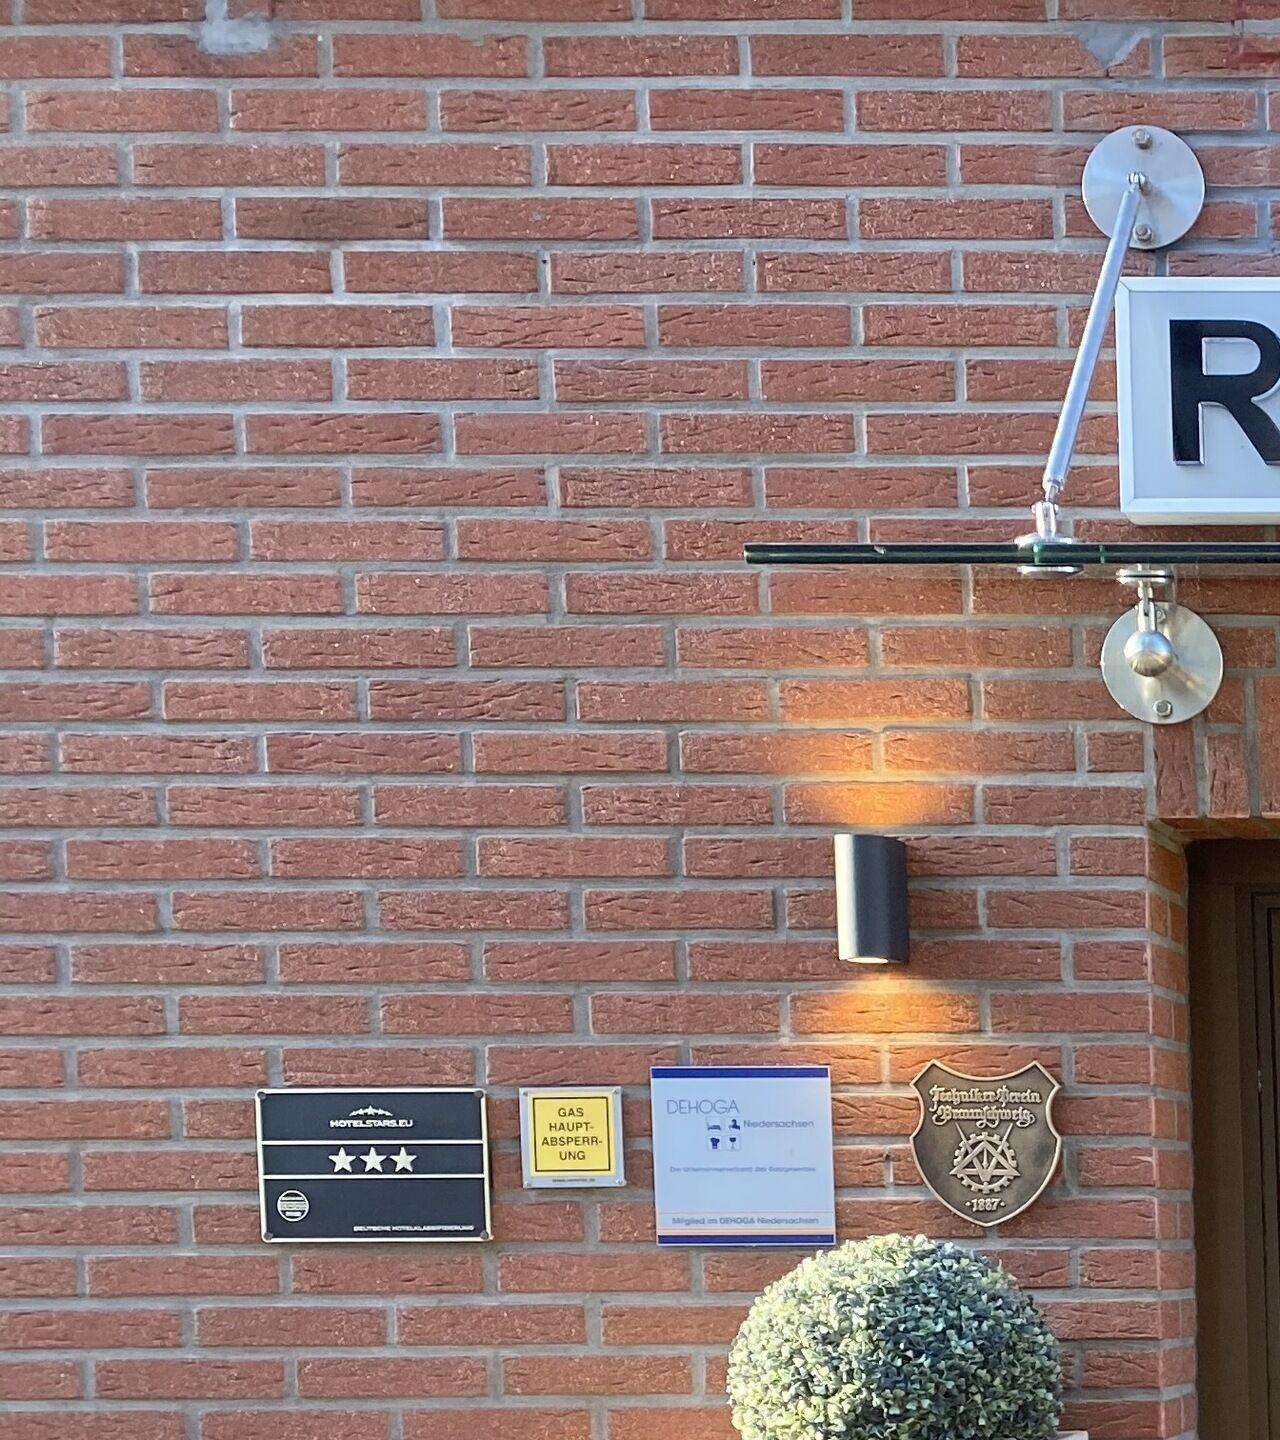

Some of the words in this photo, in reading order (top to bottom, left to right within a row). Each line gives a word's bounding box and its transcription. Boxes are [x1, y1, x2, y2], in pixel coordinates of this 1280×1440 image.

[666, 1099, 740, 1114] DEHOGA
[558, 1107, 584, 1117] GAS
[330, 1119, 414, 1128] HOTELSTARS.EU
[549, 1122, 594, 1132] HAUPT-
[743, 1119, 814, 1129] Niedersachsen
[541, 1136, 603, 1146] ABSPERR-
[559, 1151, 586, 1161] UNG
[971, 1198, 1001, 1212] 1887
[672, 1217, 706, 1226] Mitglied
[719, 1217, 755, 1225] DEHOGA
[757, 1216, 819, 1225] Niedersachsen
